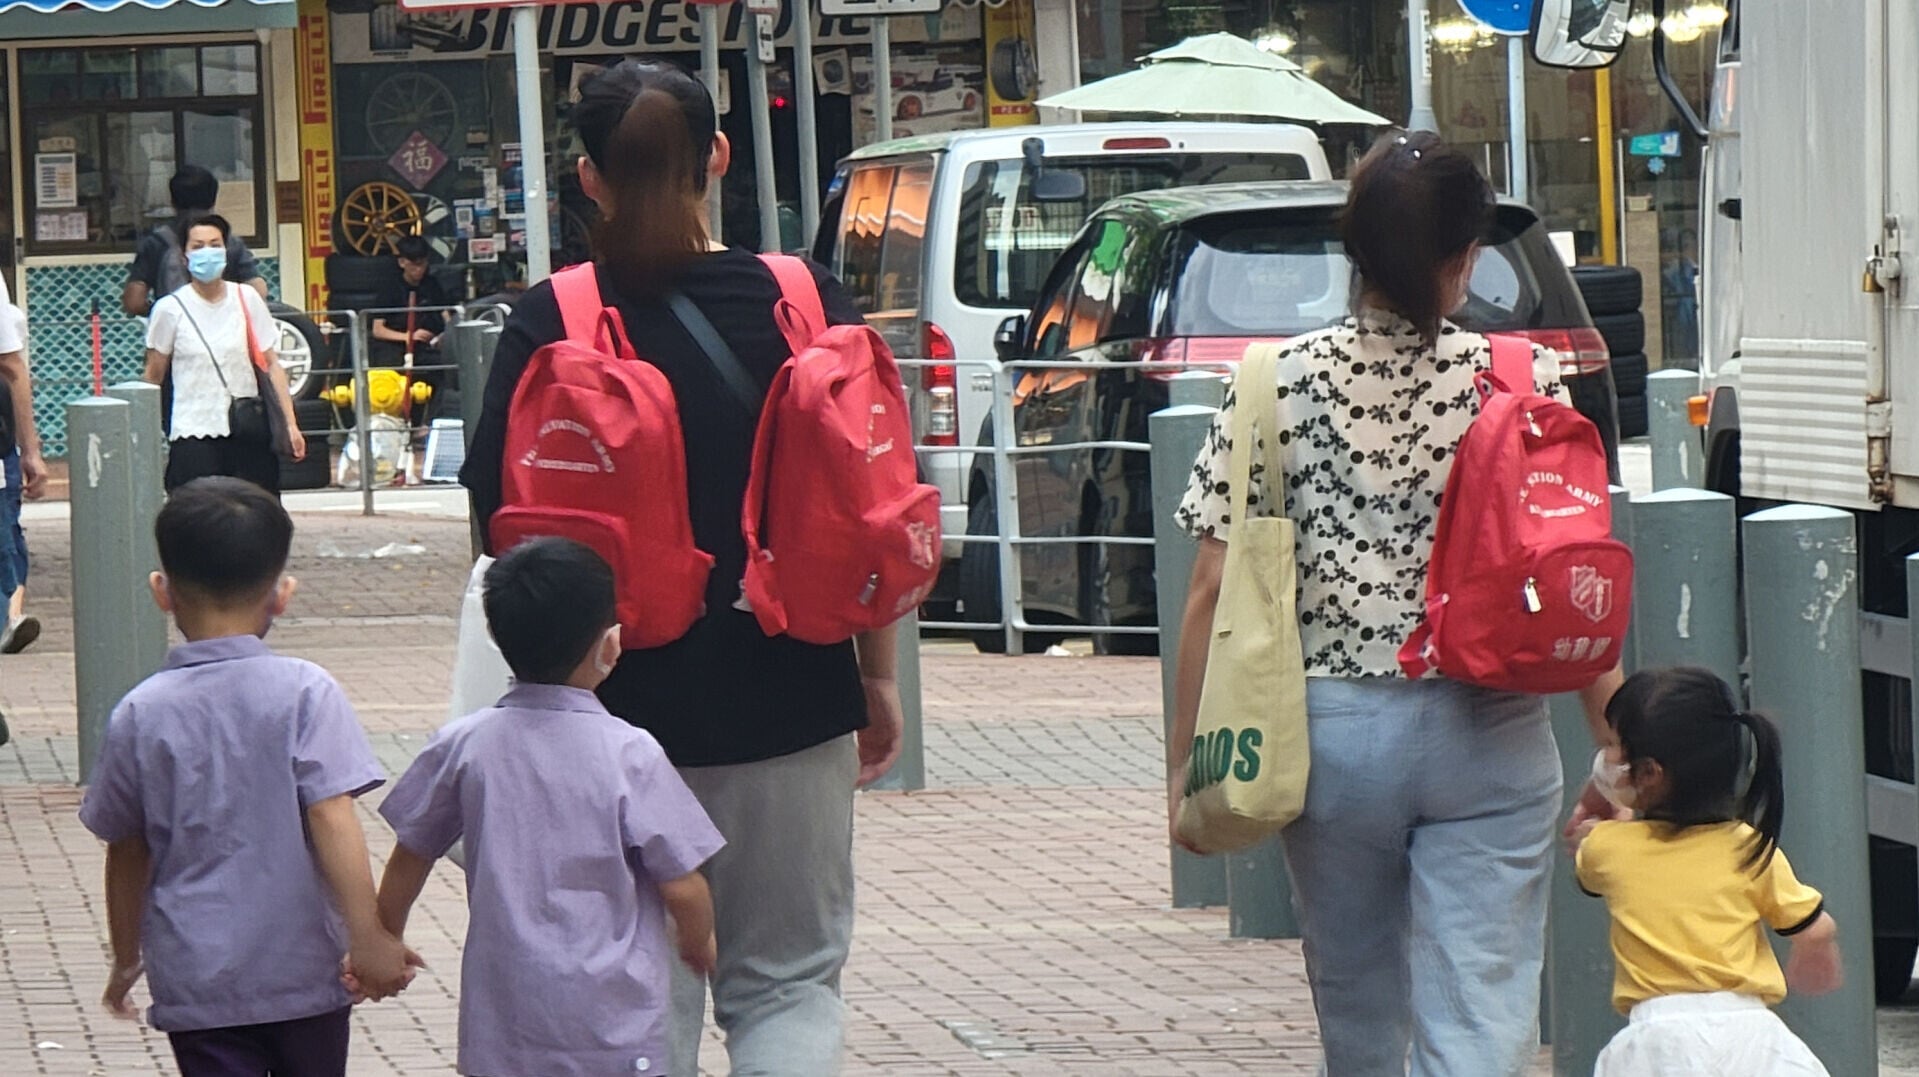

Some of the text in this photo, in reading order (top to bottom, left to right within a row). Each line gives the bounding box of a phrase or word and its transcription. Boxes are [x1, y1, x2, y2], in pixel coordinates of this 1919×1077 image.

[438, 0, 871, 51] BIDGEST
[300, 14, 327, 124] PIRELLI
[402, 140, 433, 173] 福
[305, 148, 332, 258] PIRELLI
[1565, 483, 1604, 508] ARMY
